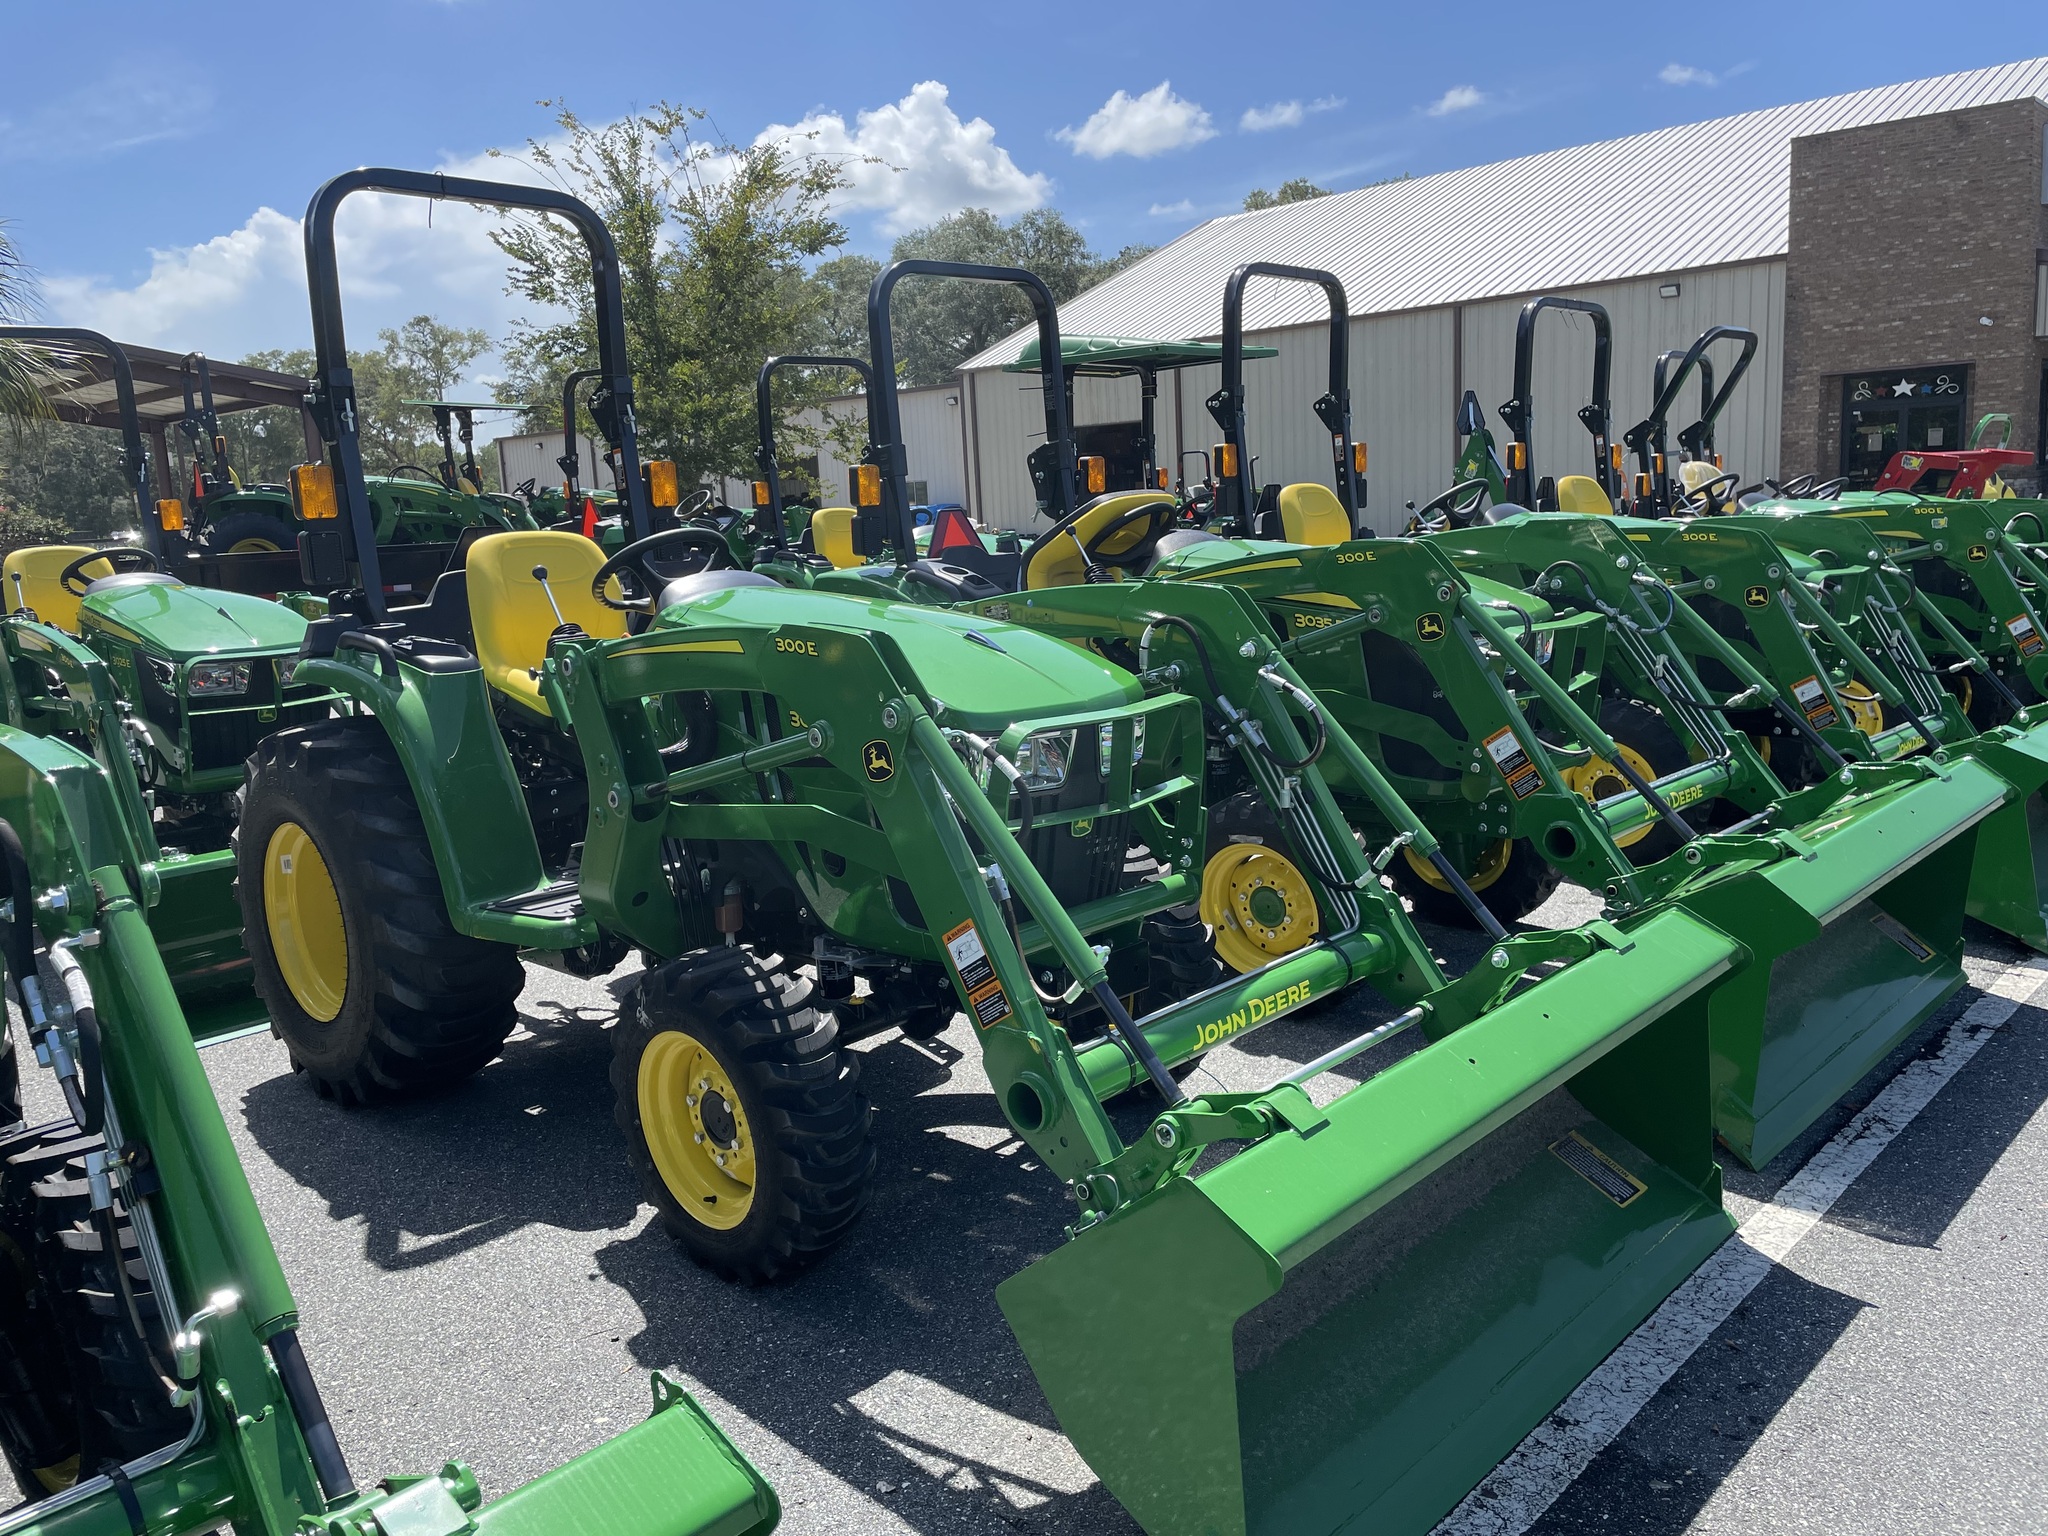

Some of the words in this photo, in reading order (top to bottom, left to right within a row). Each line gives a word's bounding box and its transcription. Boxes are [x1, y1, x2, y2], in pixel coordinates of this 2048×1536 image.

[1681, 533, 1718, 541] 300E
[1335, 551, 1377, 564] 300E
[774, 637, 819, 656] 300E
[1669, 783, 1704, 809] DEERE
[951, 922, 971, 938] WARNING
[978, 985, 999, 999] WARNING
[1193, 1008, 1247, 1051] JOHN
[1247, 979, 1311, 1024] DEERE
[1599, 1153, 1630, 1178] CAUTION
